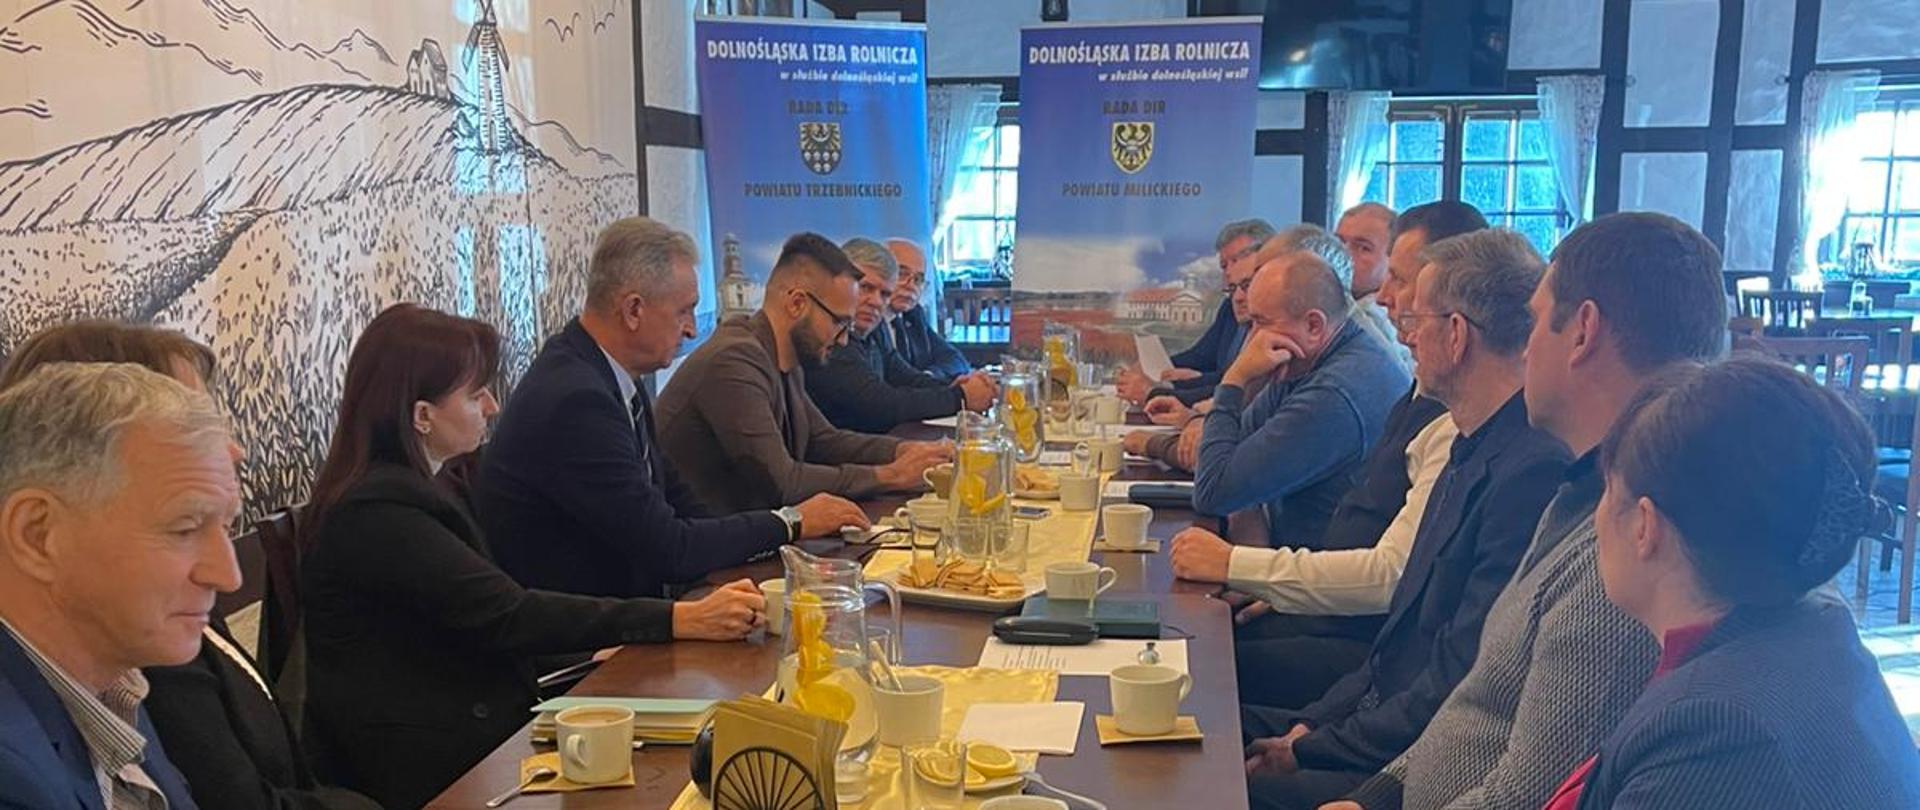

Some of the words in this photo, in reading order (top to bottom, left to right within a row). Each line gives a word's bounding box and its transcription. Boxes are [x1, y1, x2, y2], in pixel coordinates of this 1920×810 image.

[707, 37, 809, 64] DOLNOŚLĄSKA
[813, 43, 847, 63] IZBA
[851, 45, 918, 65] ROLNICZA
[1029, 40, 1130, 66] DOLNOŚLĄSKA
[1135, 43, 1170, 62] IZBA
[1175, 41, 1250, 61] ROLNICZA
[780, 72, 790, 80] w
[1098, 73, 1109, 82] w
[1110, 69, 1149, 82] służbie
[787, 100, 822, 115] RADA
[1103, 100, 1139, 115] RADA
[1143, 100, 1166, 115] DIR
[744, 183, 802, 197] POWIATU
[806, 183, 902, 198] TRZEBNICKIEGO
[1062, 182, 1120, 197] POWIATU
[1123, 182, 1202, 197] MILICKIEGO
